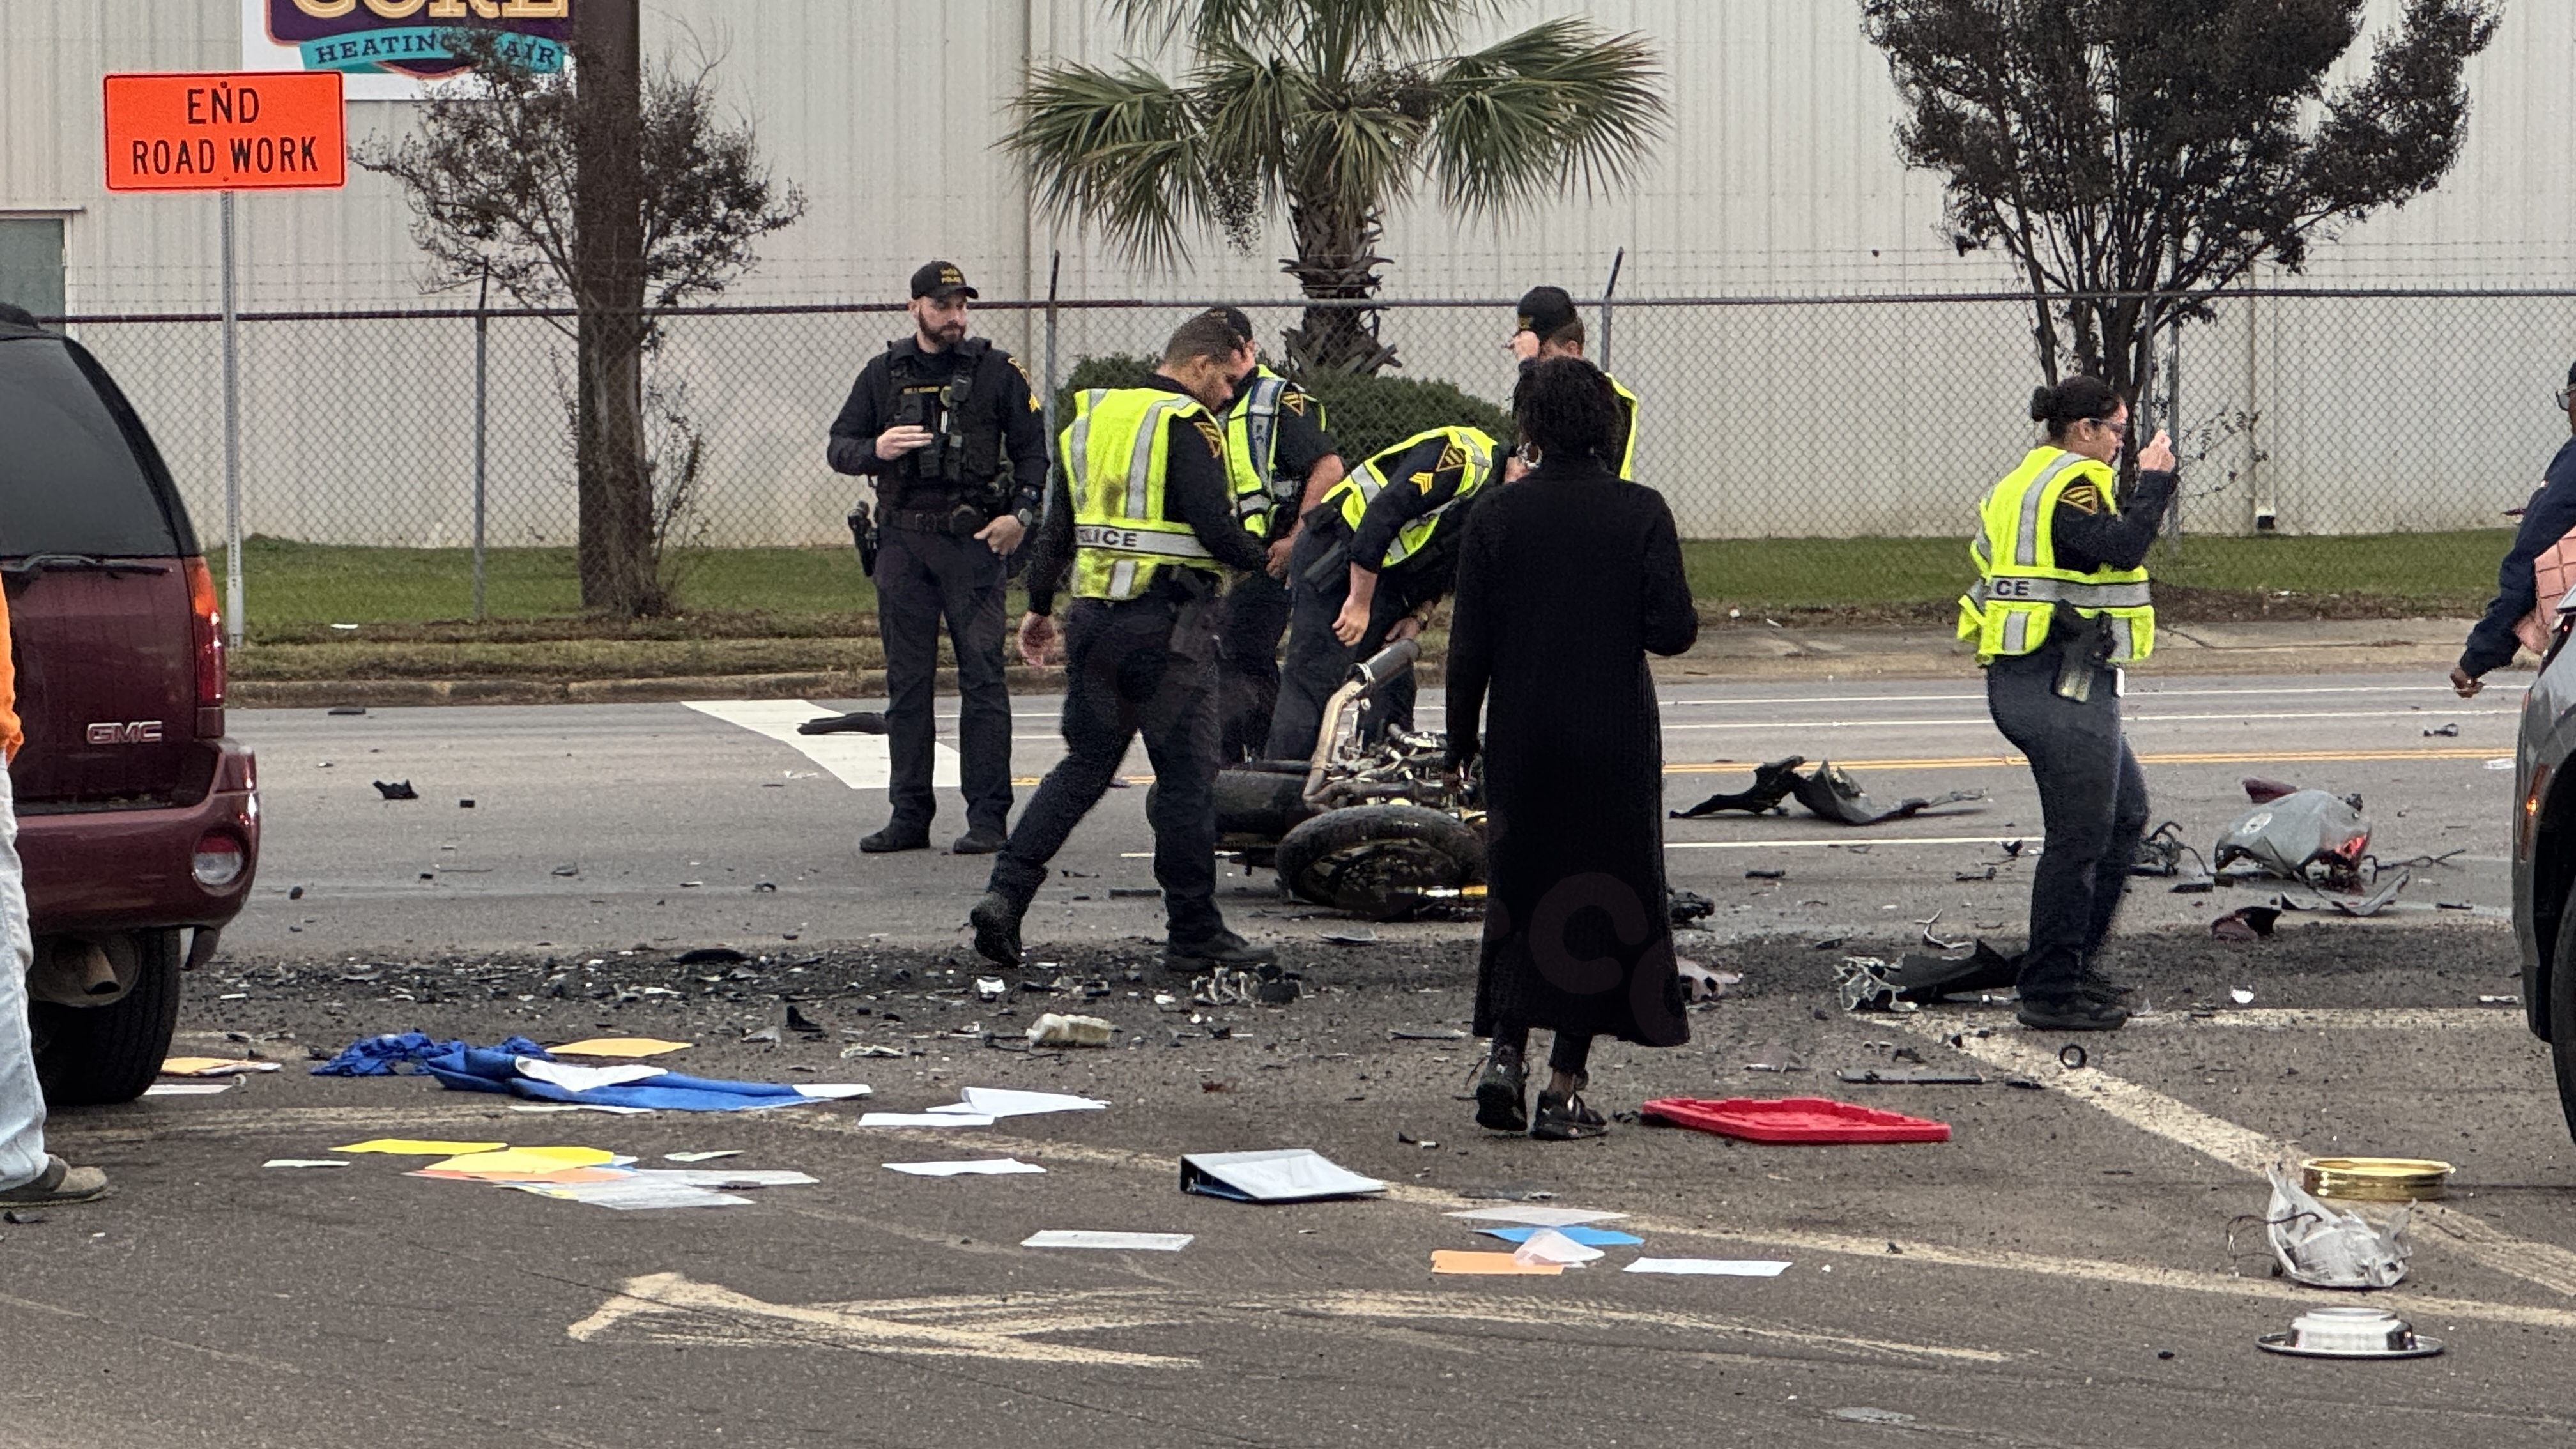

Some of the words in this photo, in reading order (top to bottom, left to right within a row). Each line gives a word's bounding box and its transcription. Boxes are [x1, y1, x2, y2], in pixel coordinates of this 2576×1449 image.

[503, 40, 554, 63] AIR
[188, 88, 259, 124] END
[132, 139, 215, 174] ROAD
[230, 136, 319, 173] WORK
[87, 720, 162, 744] GMC
